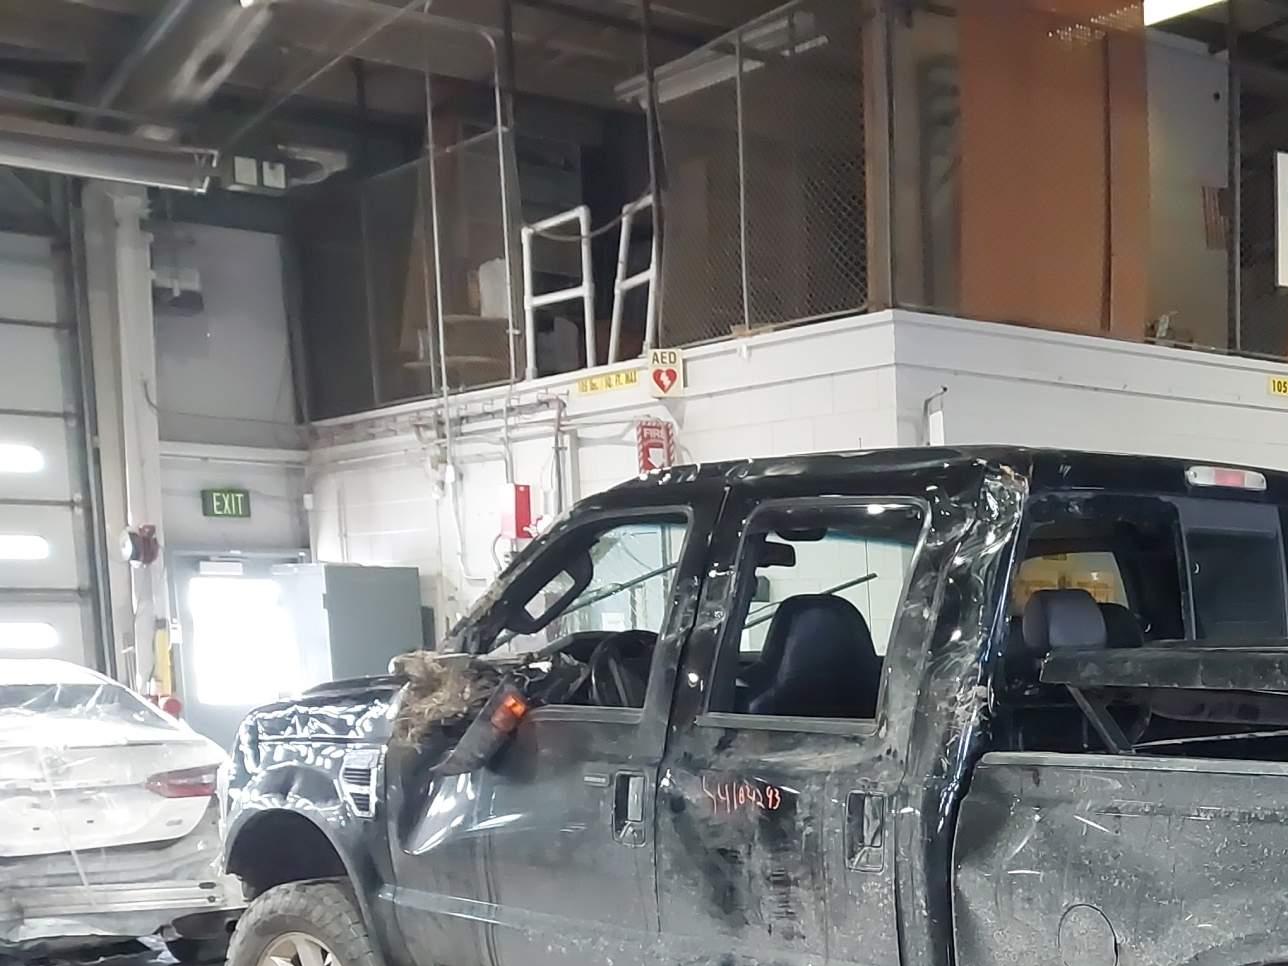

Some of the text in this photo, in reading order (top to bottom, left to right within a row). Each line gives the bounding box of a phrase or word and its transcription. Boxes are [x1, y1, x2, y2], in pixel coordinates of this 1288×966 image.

[652, 351, 677, 365] AED
[1272, 380, 1288, 394] 105
[212, 492, 244, 515] EXIT
